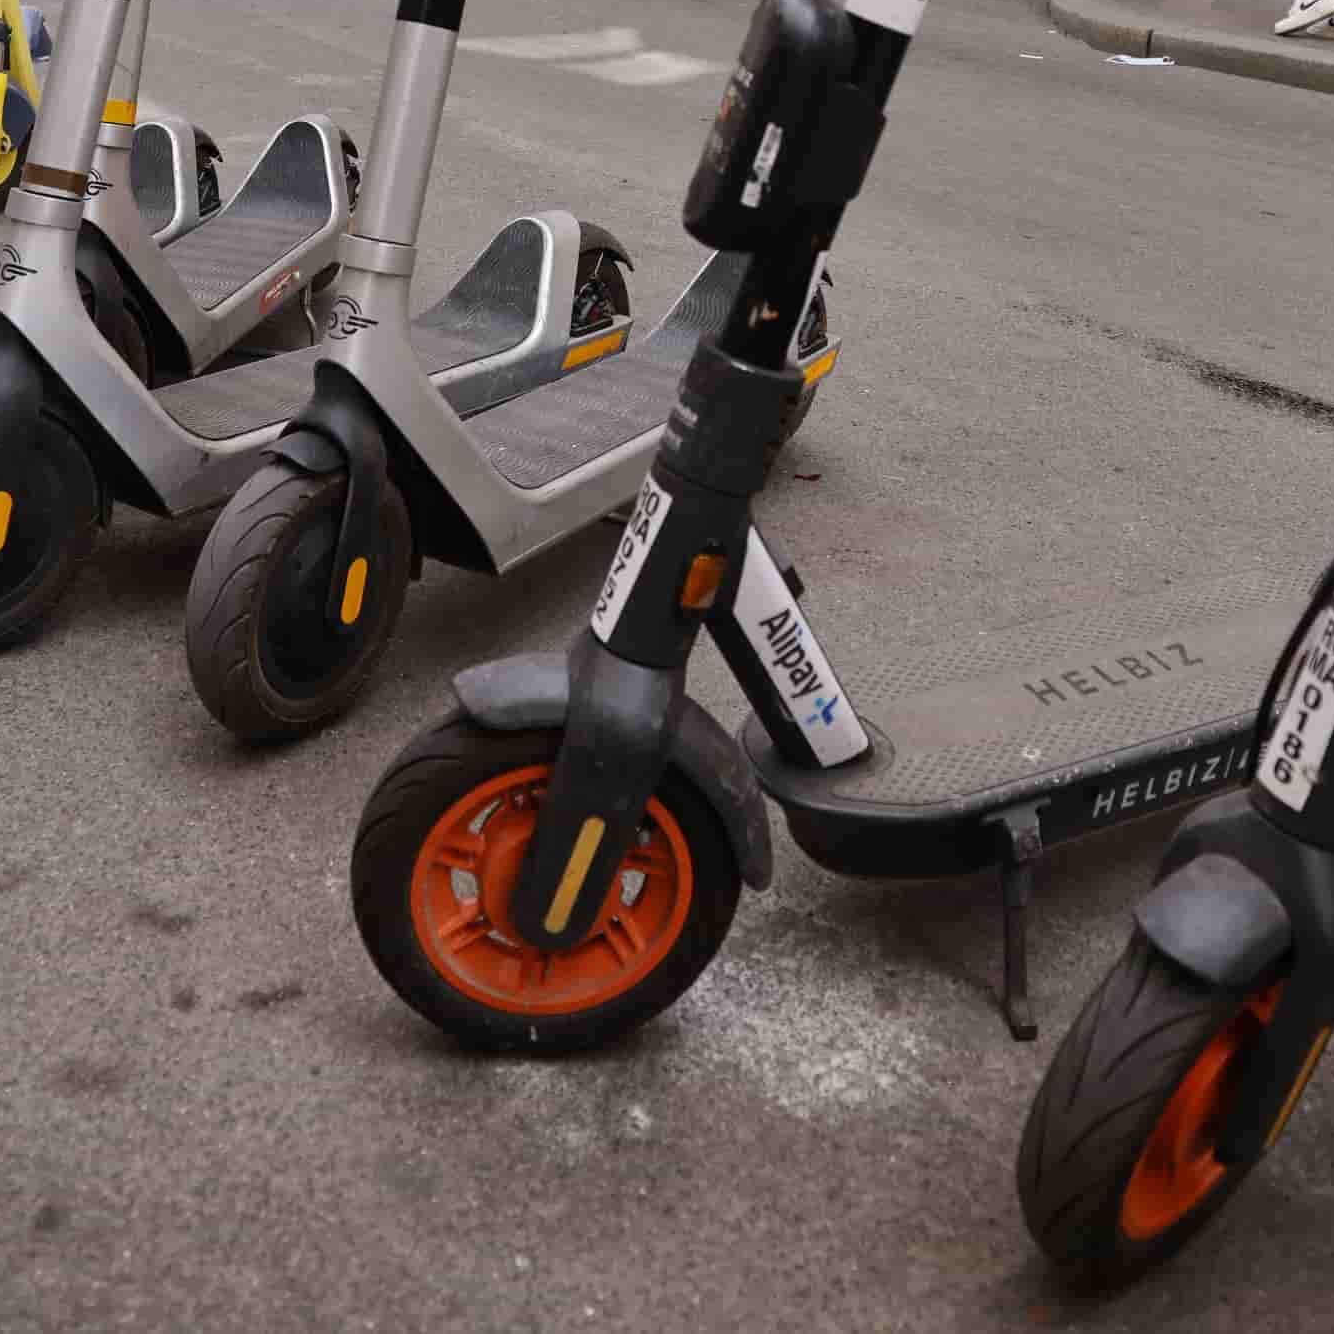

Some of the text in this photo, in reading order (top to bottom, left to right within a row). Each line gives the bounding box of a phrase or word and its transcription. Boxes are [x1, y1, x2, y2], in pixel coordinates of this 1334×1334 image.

[758, 607, 824, 700] Alipay
[1022, 642, 1204, 707] HELBIZ
[1092, 756, 1222, 818] HELBIZ
